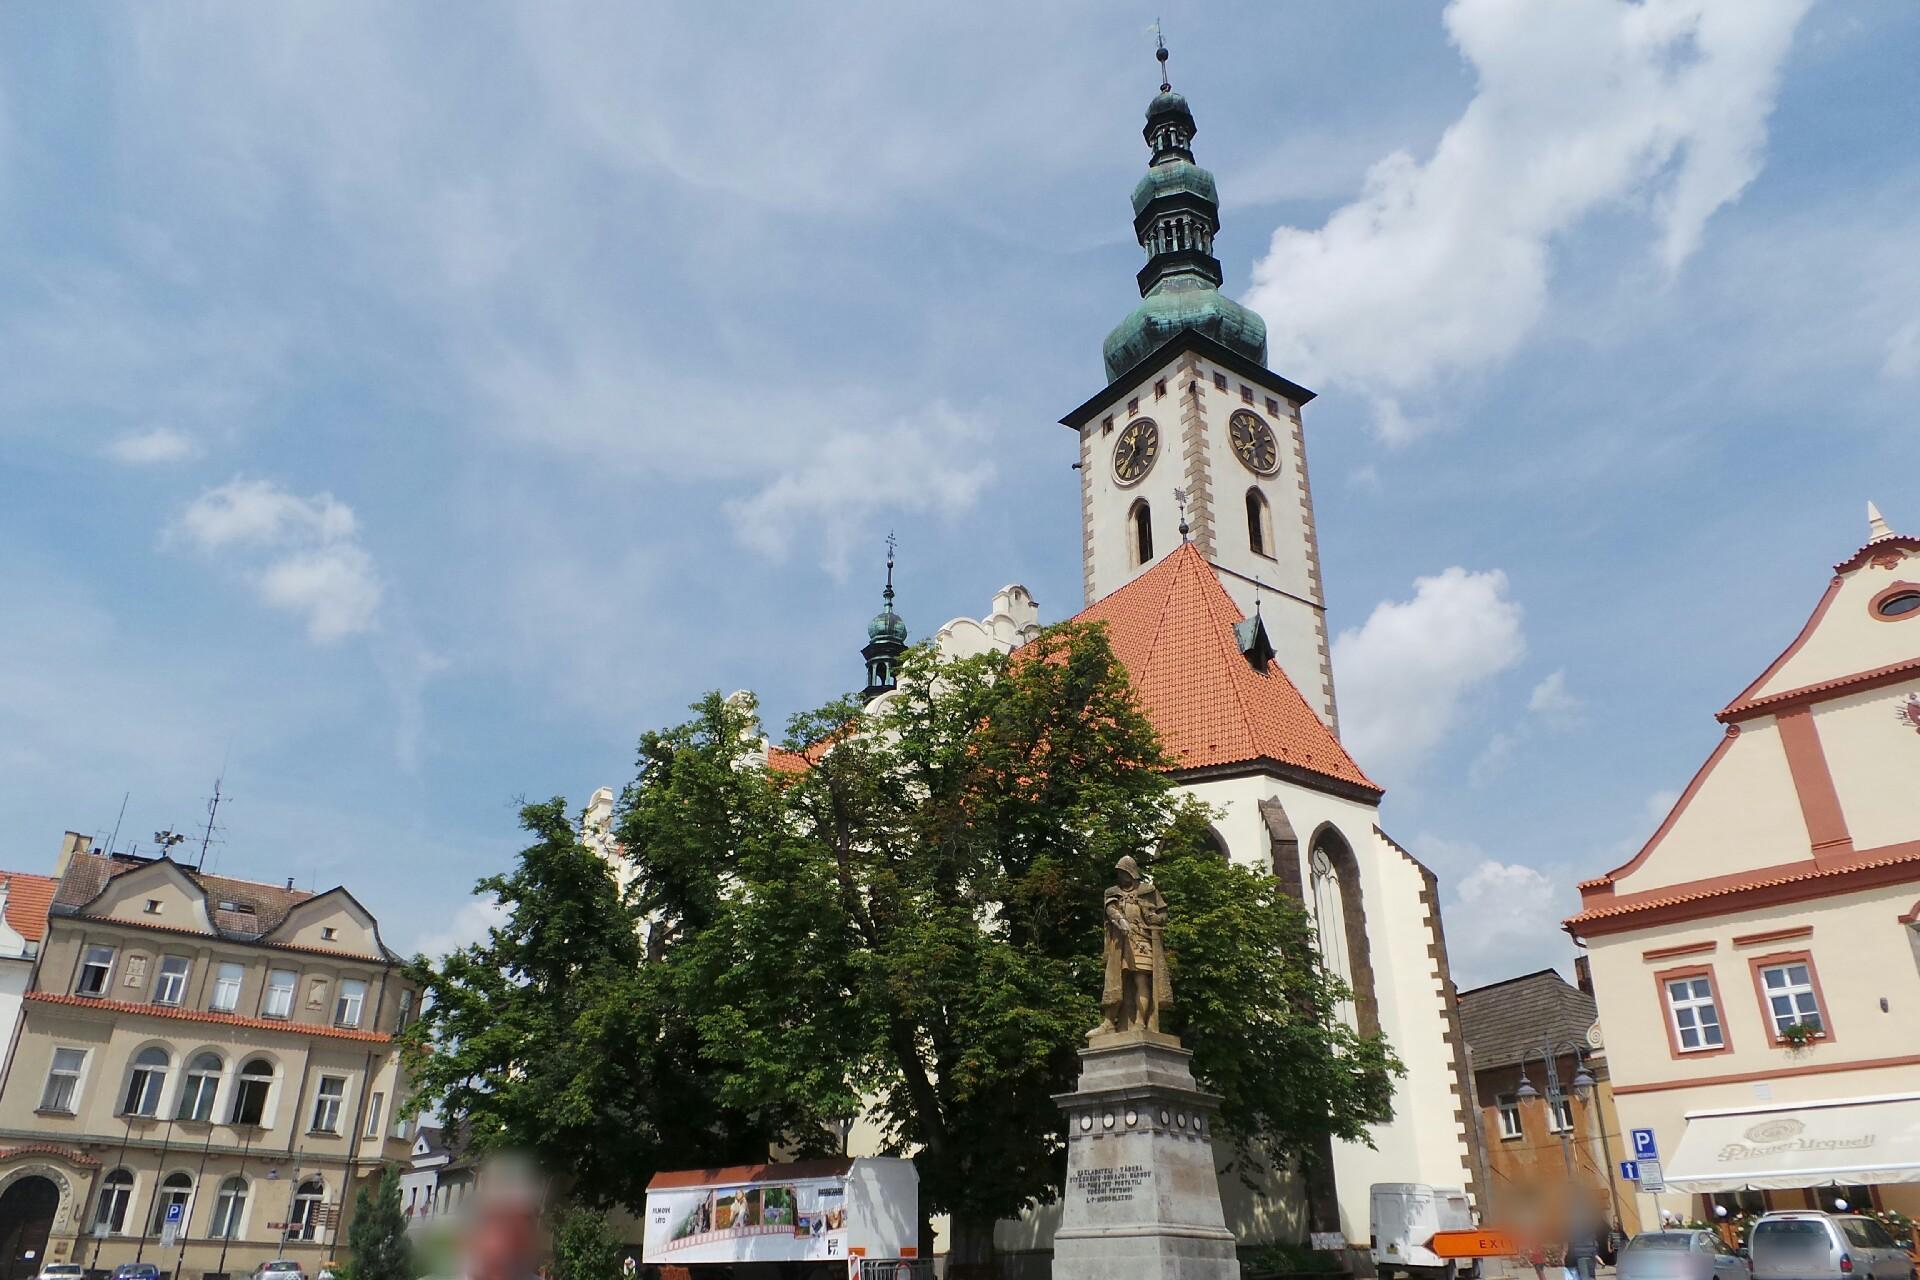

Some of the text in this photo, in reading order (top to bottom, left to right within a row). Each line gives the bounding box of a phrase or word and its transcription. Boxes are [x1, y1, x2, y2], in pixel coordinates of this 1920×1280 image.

[1635, 1132, 1650, 1152] P
[1717, 1134, 1876, 1162] Pilsner Urquell
[169, 1206, 179, 1218] P
